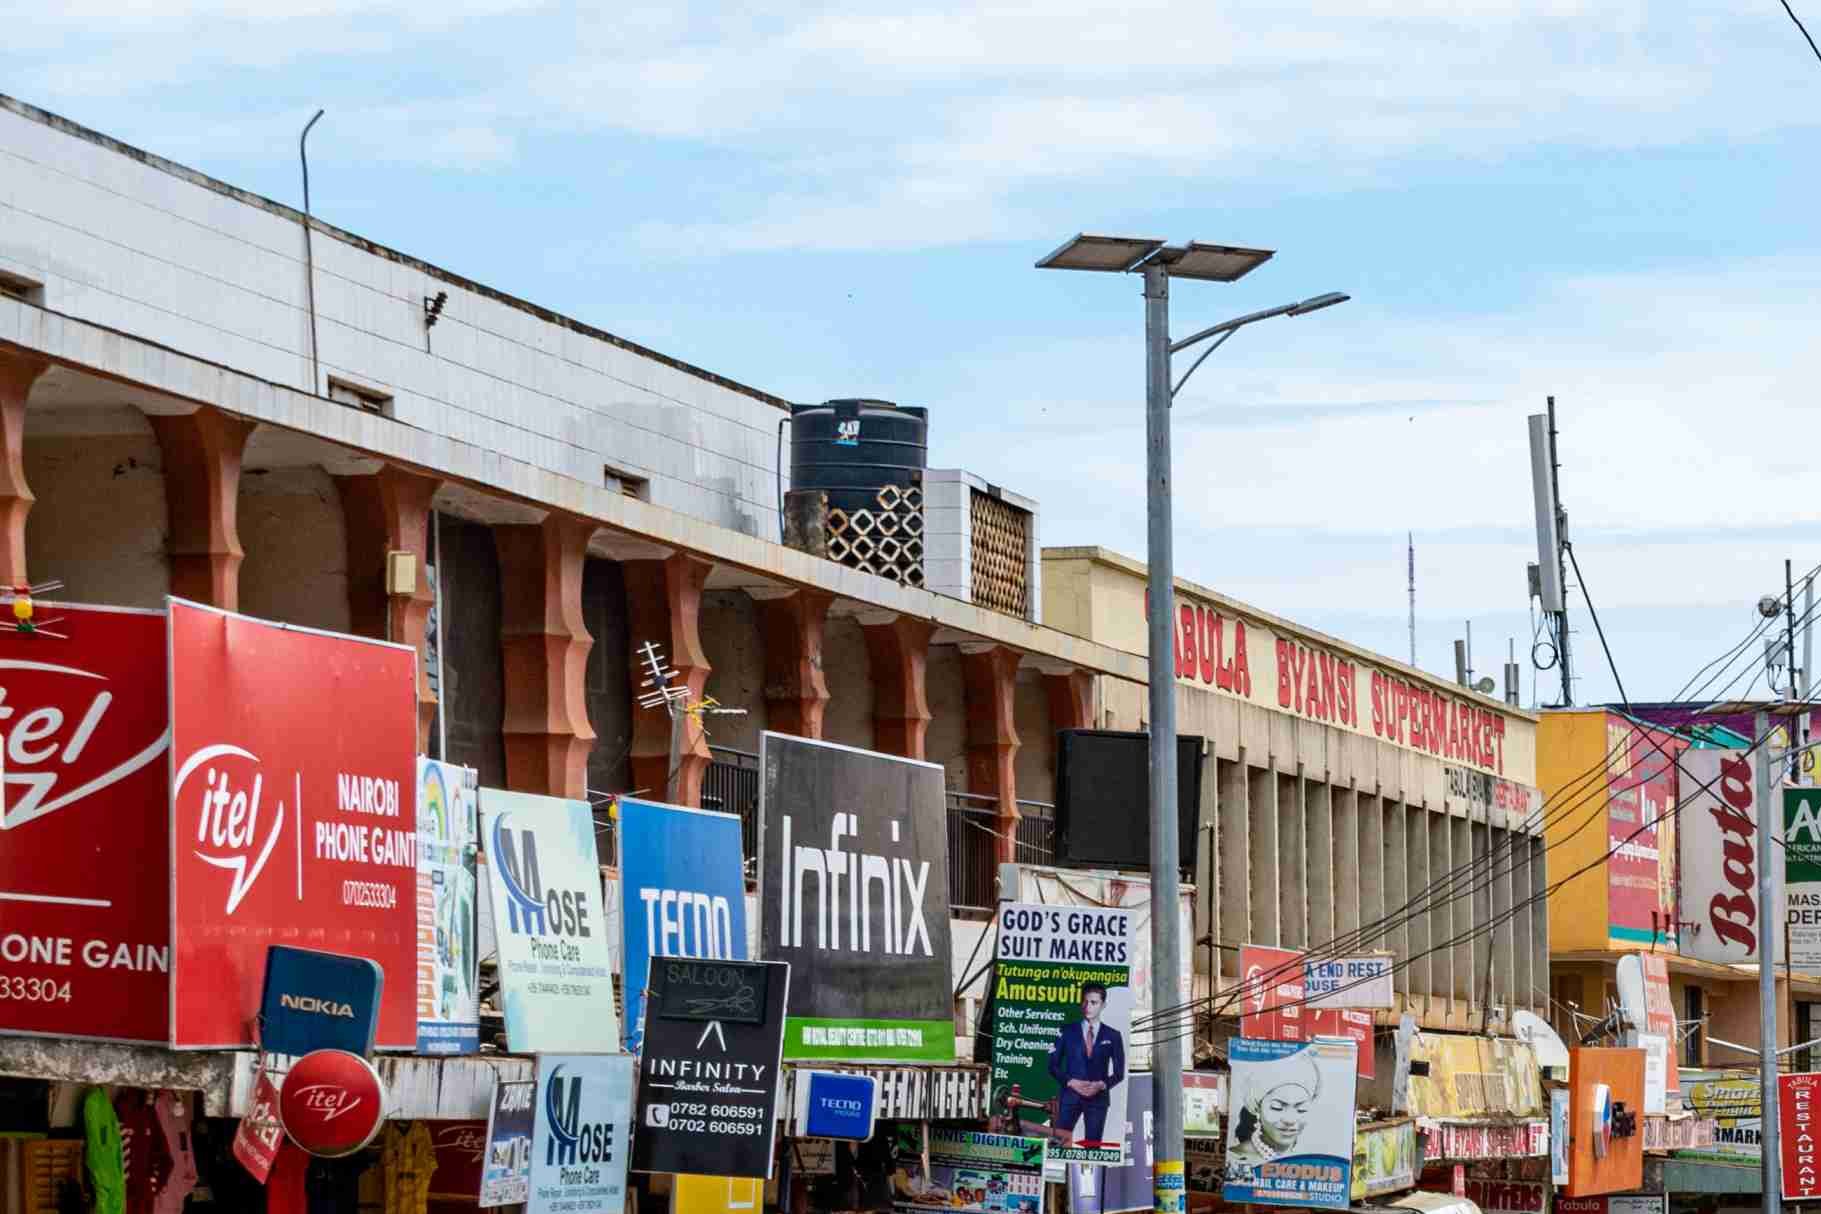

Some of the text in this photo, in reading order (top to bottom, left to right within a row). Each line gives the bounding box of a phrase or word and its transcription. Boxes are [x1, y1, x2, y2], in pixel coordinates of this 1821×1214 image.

[1275, 637, 1357, 729] BYANSI
[1371, 670, 1505, 776] SUPERMARKET
[338, 773, 400, 817] NAIROBI
[199, 768, 263, 848] itel
[315, 822, 369, 863] PHONE
[1709, 751, 1757, 956] Bata
[780, 812, 934, 957] Infinix
[1003, 909, 1127, 937] GOD'S GRACE
[531, 938, 581, 962] Phone Care
[1002, 935, 1127, 963] SUIT MAKERS
[667, 964, 745, 986] SALOON
[998, 963, 1050, 981] Tutunga
[1317, 962, 1343, 978] END
[1347, 962, 1385, 977] REST
[996, 977, 1083, 1004] Amasuuti
[280, 994, 354, 1018] NOKIA
[998, 1007, 1065, 1022] Other Services:
[999, 1022, 1062, 1038] Sch. Uniforms,
[995, 1037, 1013, 1052] Dry
[651, 1058, 766, 1081] INFINITY
[996, 1052, 1034, 1068] Training
[995, 1067, 1008, 1080] Etc
[306, 1088, 347, 1109] itel
[820, 1097, 862, 1111] TECNO
[671, 1102, 764, 1119] 0782 606591
[669, 1118, 763, 1136] 0702 606591
[454, 1129, 487, 1150] ite
[972, 1131, 1028, 1149] DIGITAL
[1795, 1089, 1816, 1197] RESTAURANT
[560, 1166, 600, 1185] Phone Care
[1275, 1178, 1297, 1191] CARE
[1308, 1181, 1345, 1194] MAKEUP
